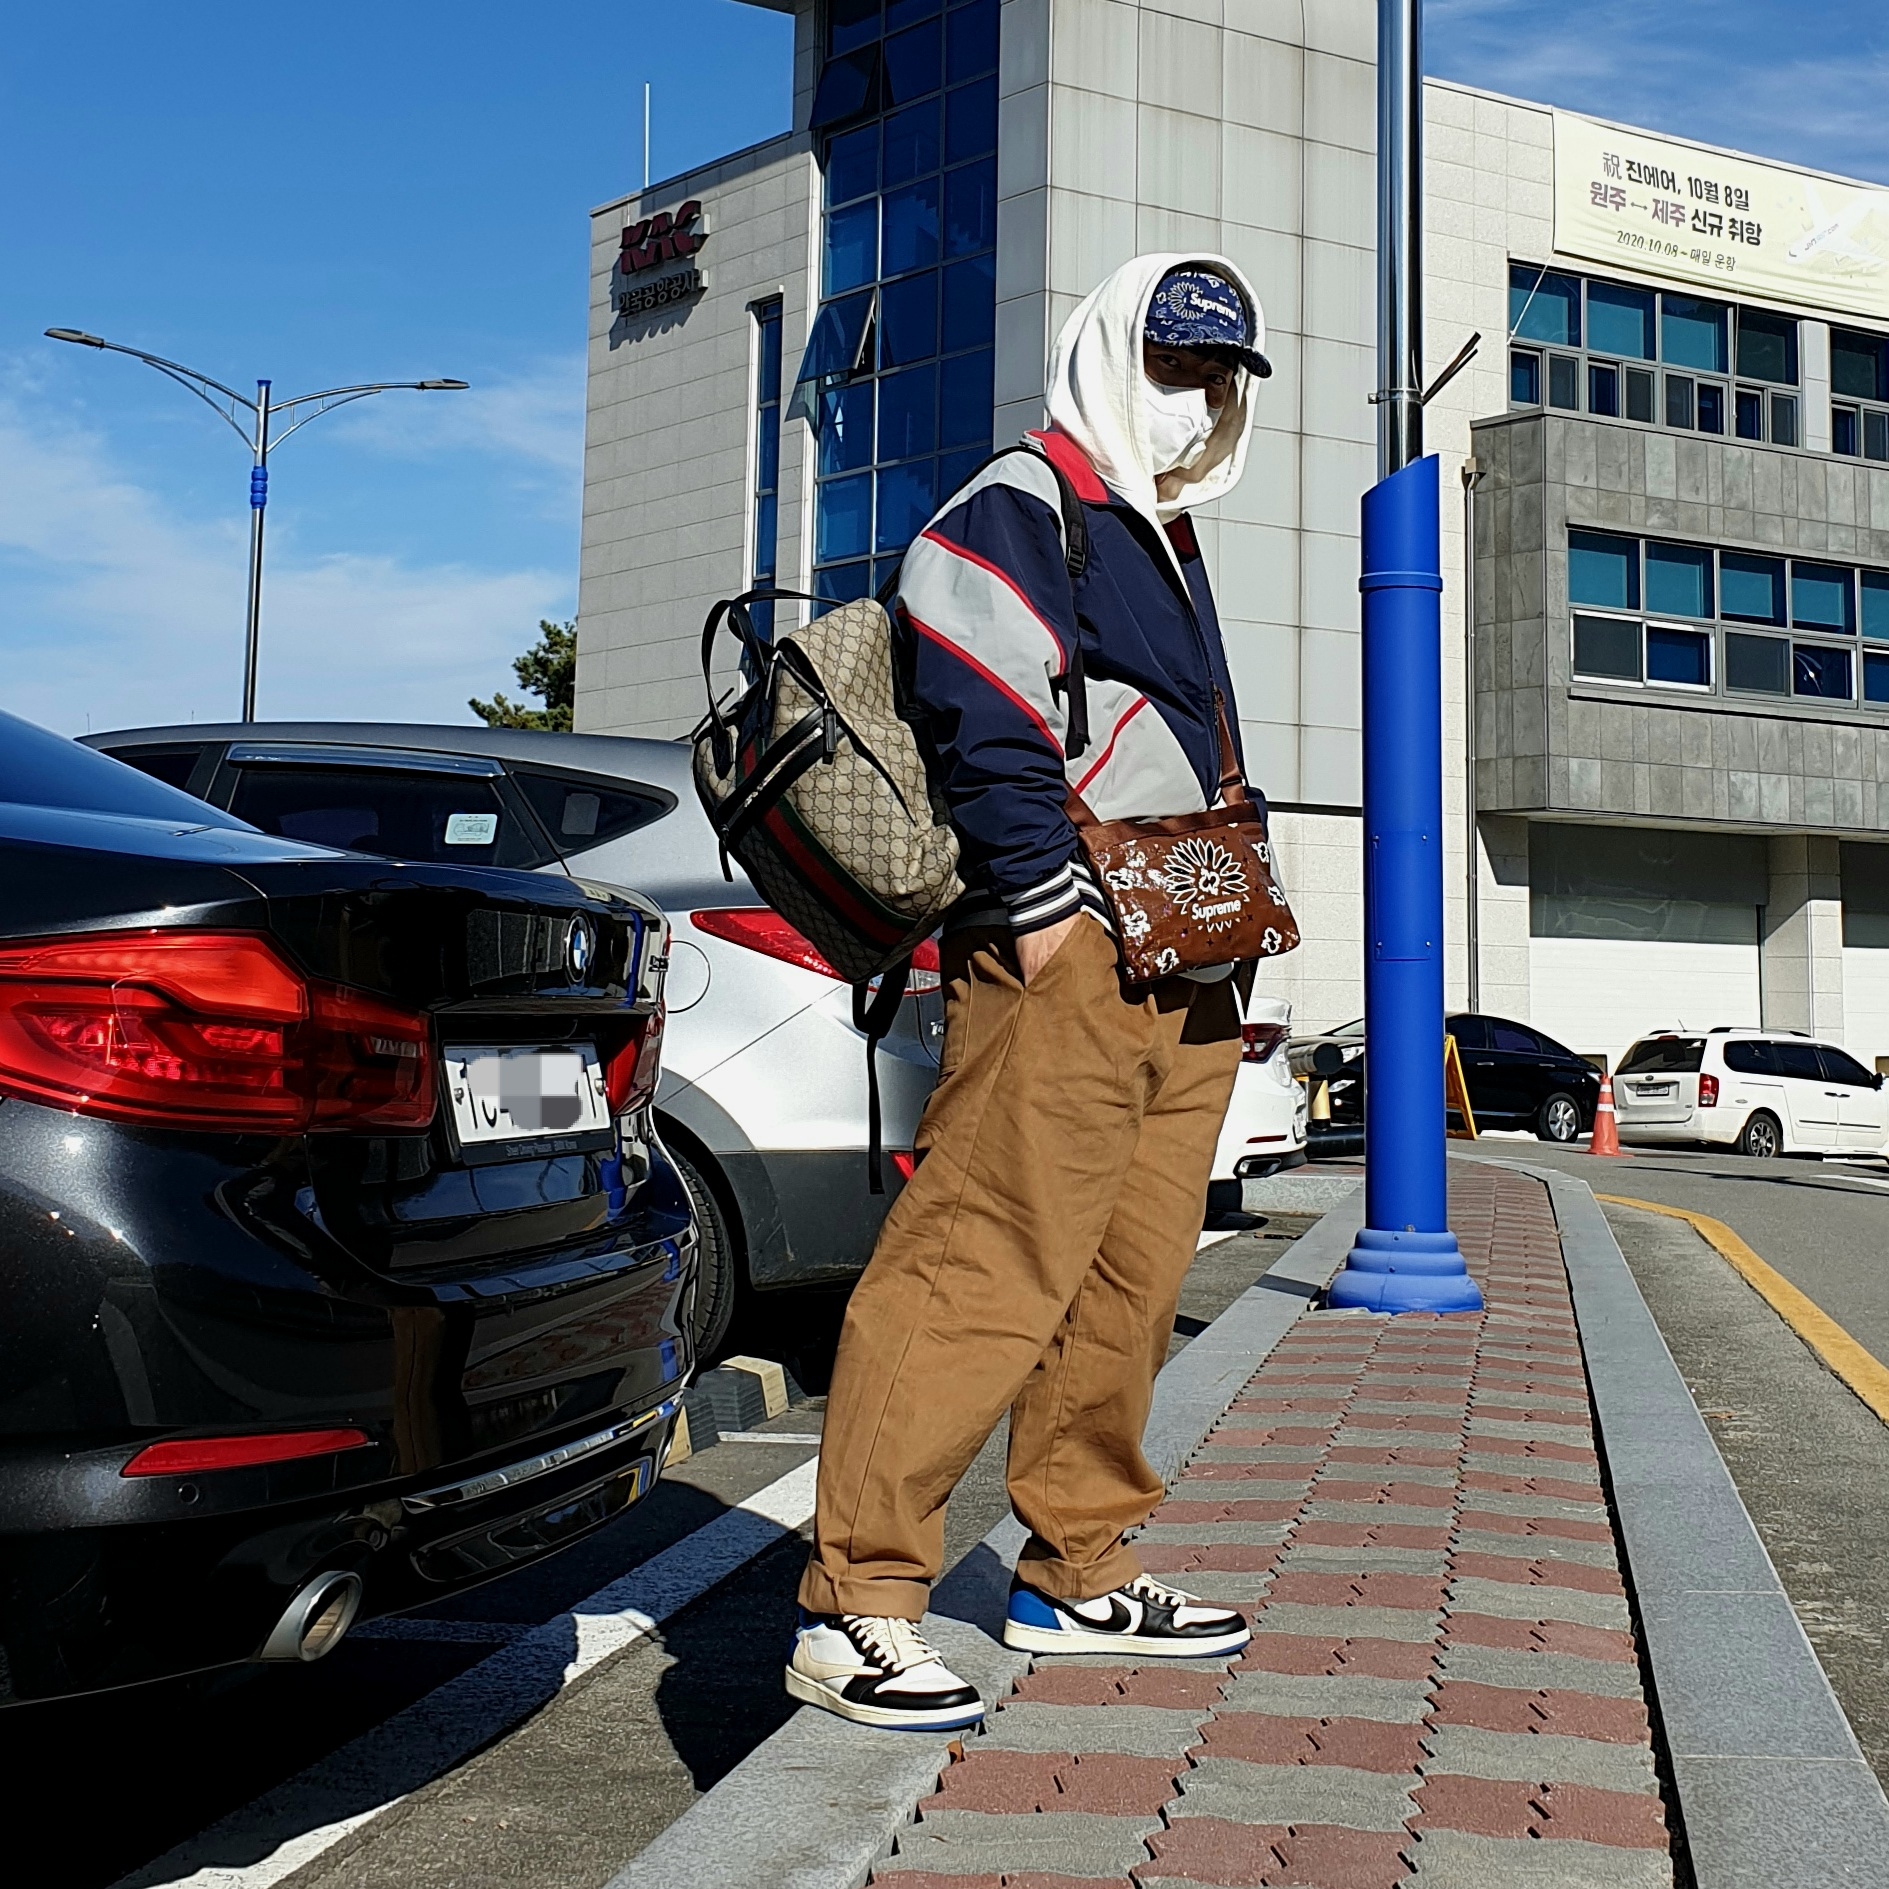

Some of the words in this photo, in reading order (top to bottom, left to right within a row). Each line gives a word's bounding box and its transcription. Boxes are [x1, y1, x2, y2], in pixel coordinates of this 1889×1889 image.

[1603, 152, 1622, 180] 祝
[1625, 159, 1681, 195] 진에어,
[1687, 176, 1719, 204] 10월
[1724, 185, 1749, 211] 8일
[1590, 181, 1626, 212] 원주
[1652, 198, 1686, 228] 제주
[1691, 208, 1723, 238] 신규
[1728, 217, 1762, 246] 취항
[1690, 248, 1712, 266] 매일
[1715, 253, 1736, 272] 운항
[1190, 293, 1237, 321] Supreme
[1191, 899, 1241, 923] Supreme
